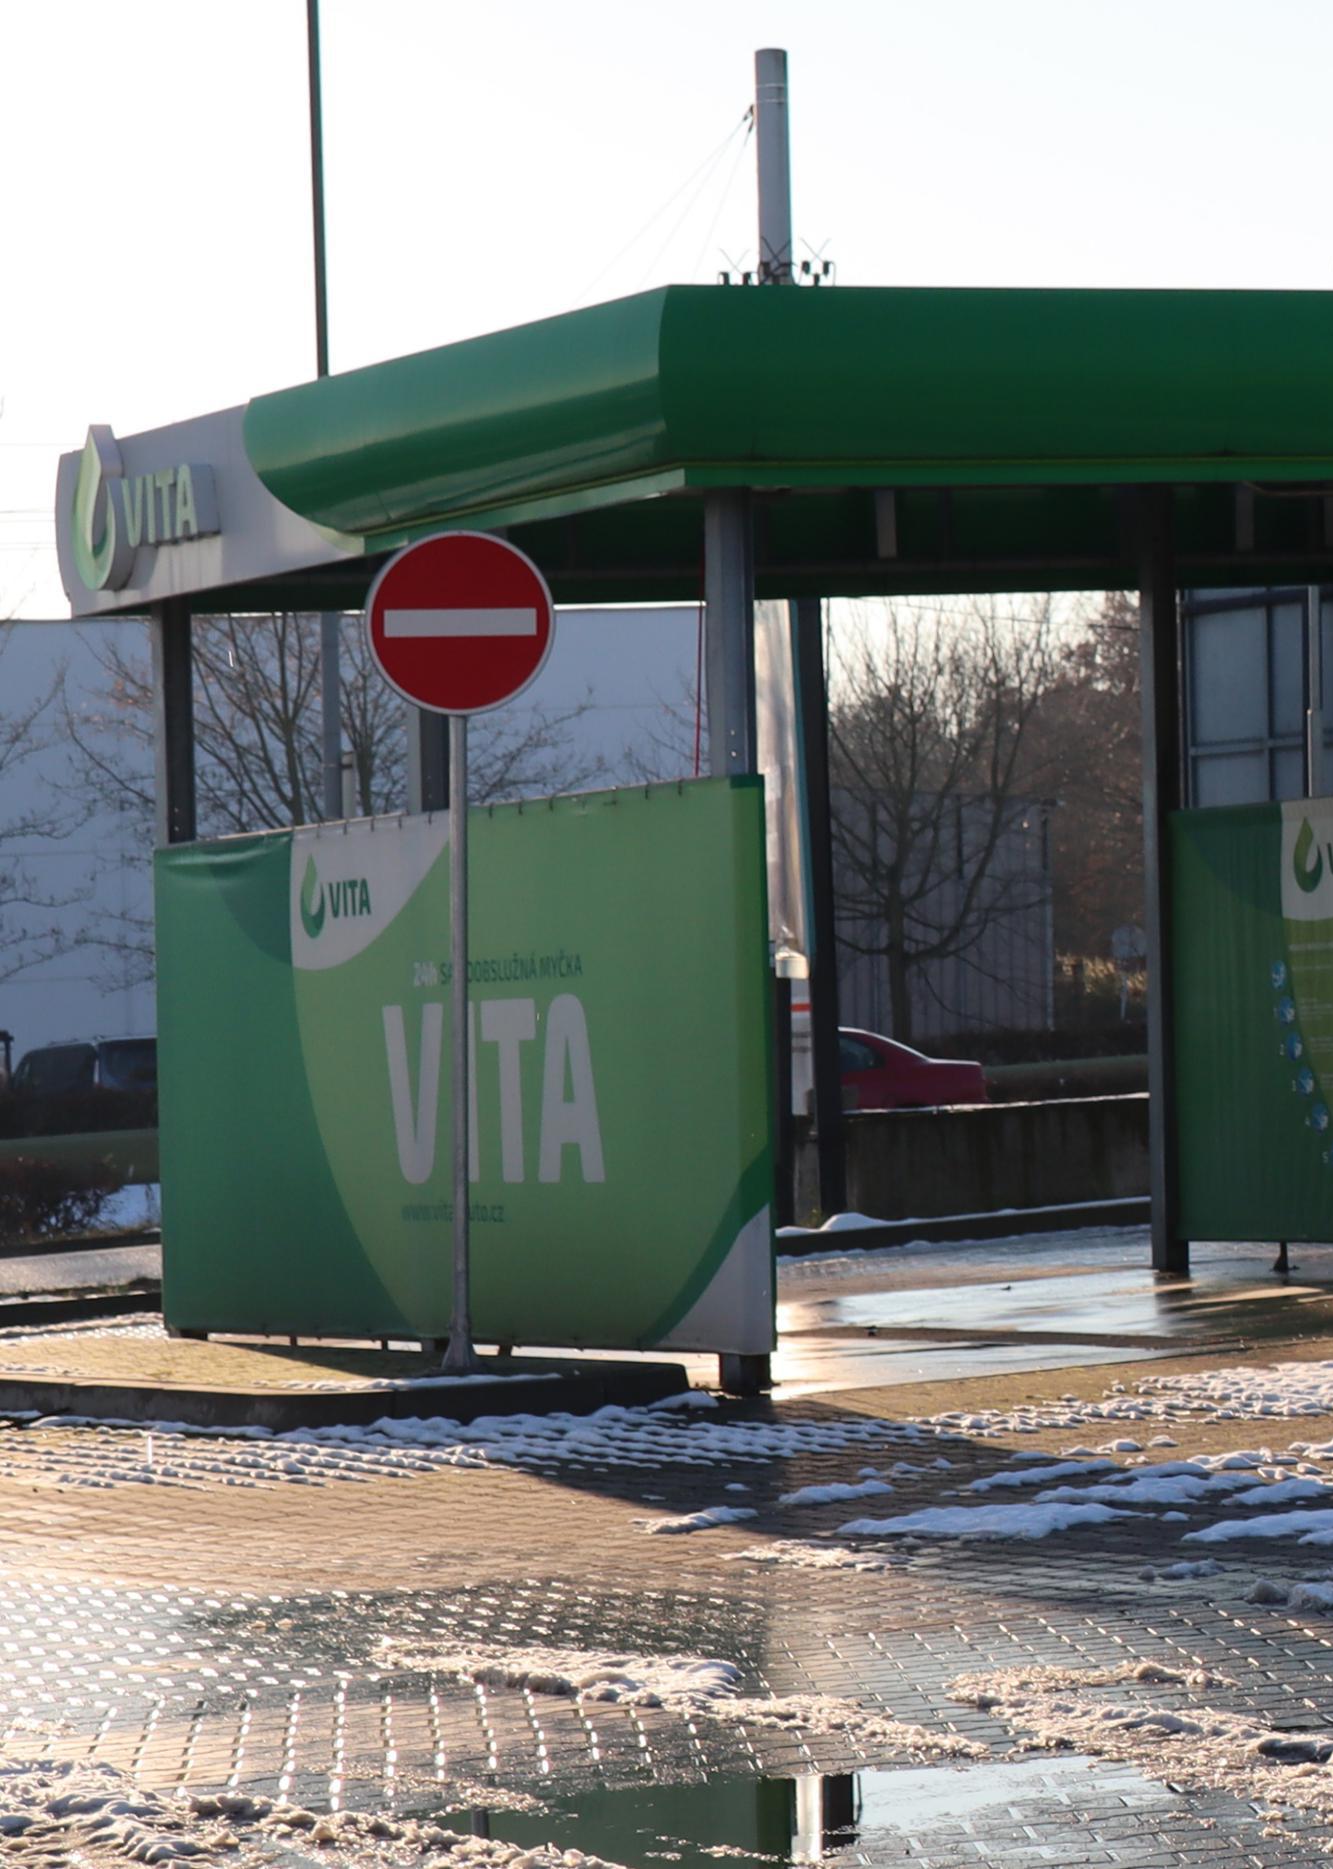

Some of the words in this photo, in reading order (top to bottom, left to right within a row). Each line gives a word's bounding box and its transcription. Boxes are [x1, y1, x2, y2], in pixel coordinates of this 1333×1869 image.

[122, 463, 198, 549] VITA
[328, 877, 372, 919] VITA
[540, 948, 583, 978] MYČKA
